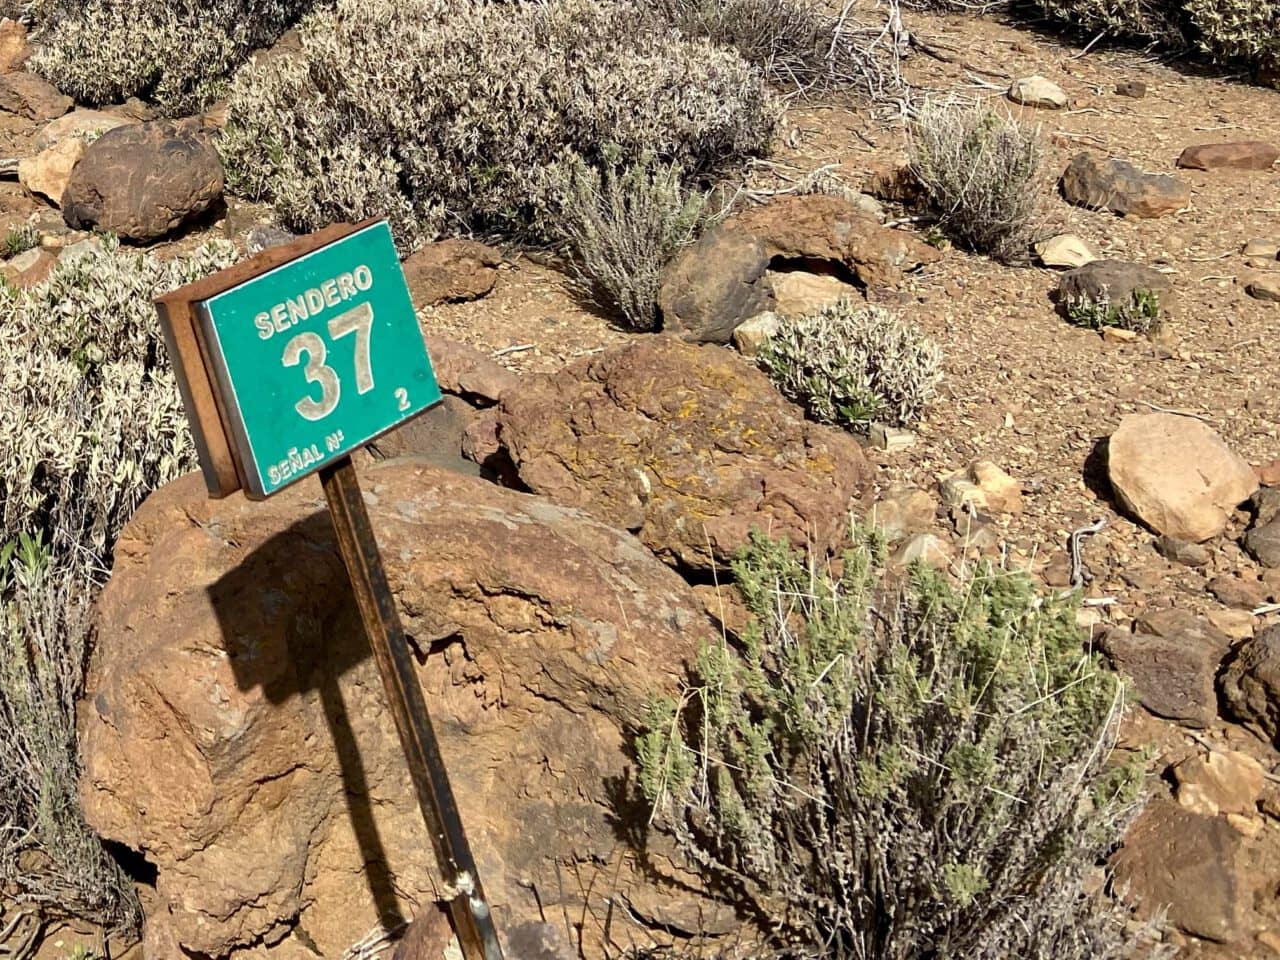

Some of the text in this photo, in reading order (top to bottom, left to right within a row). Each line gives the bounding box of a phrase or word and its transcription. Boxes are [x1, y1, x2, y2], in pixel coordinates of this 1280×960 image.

[254, 264, 373, 340] SENDERO
[281, 301, 375, 421] 37
[266, 444, 325, 486] SEÑAL
[394, 387, 411, 412] 2
